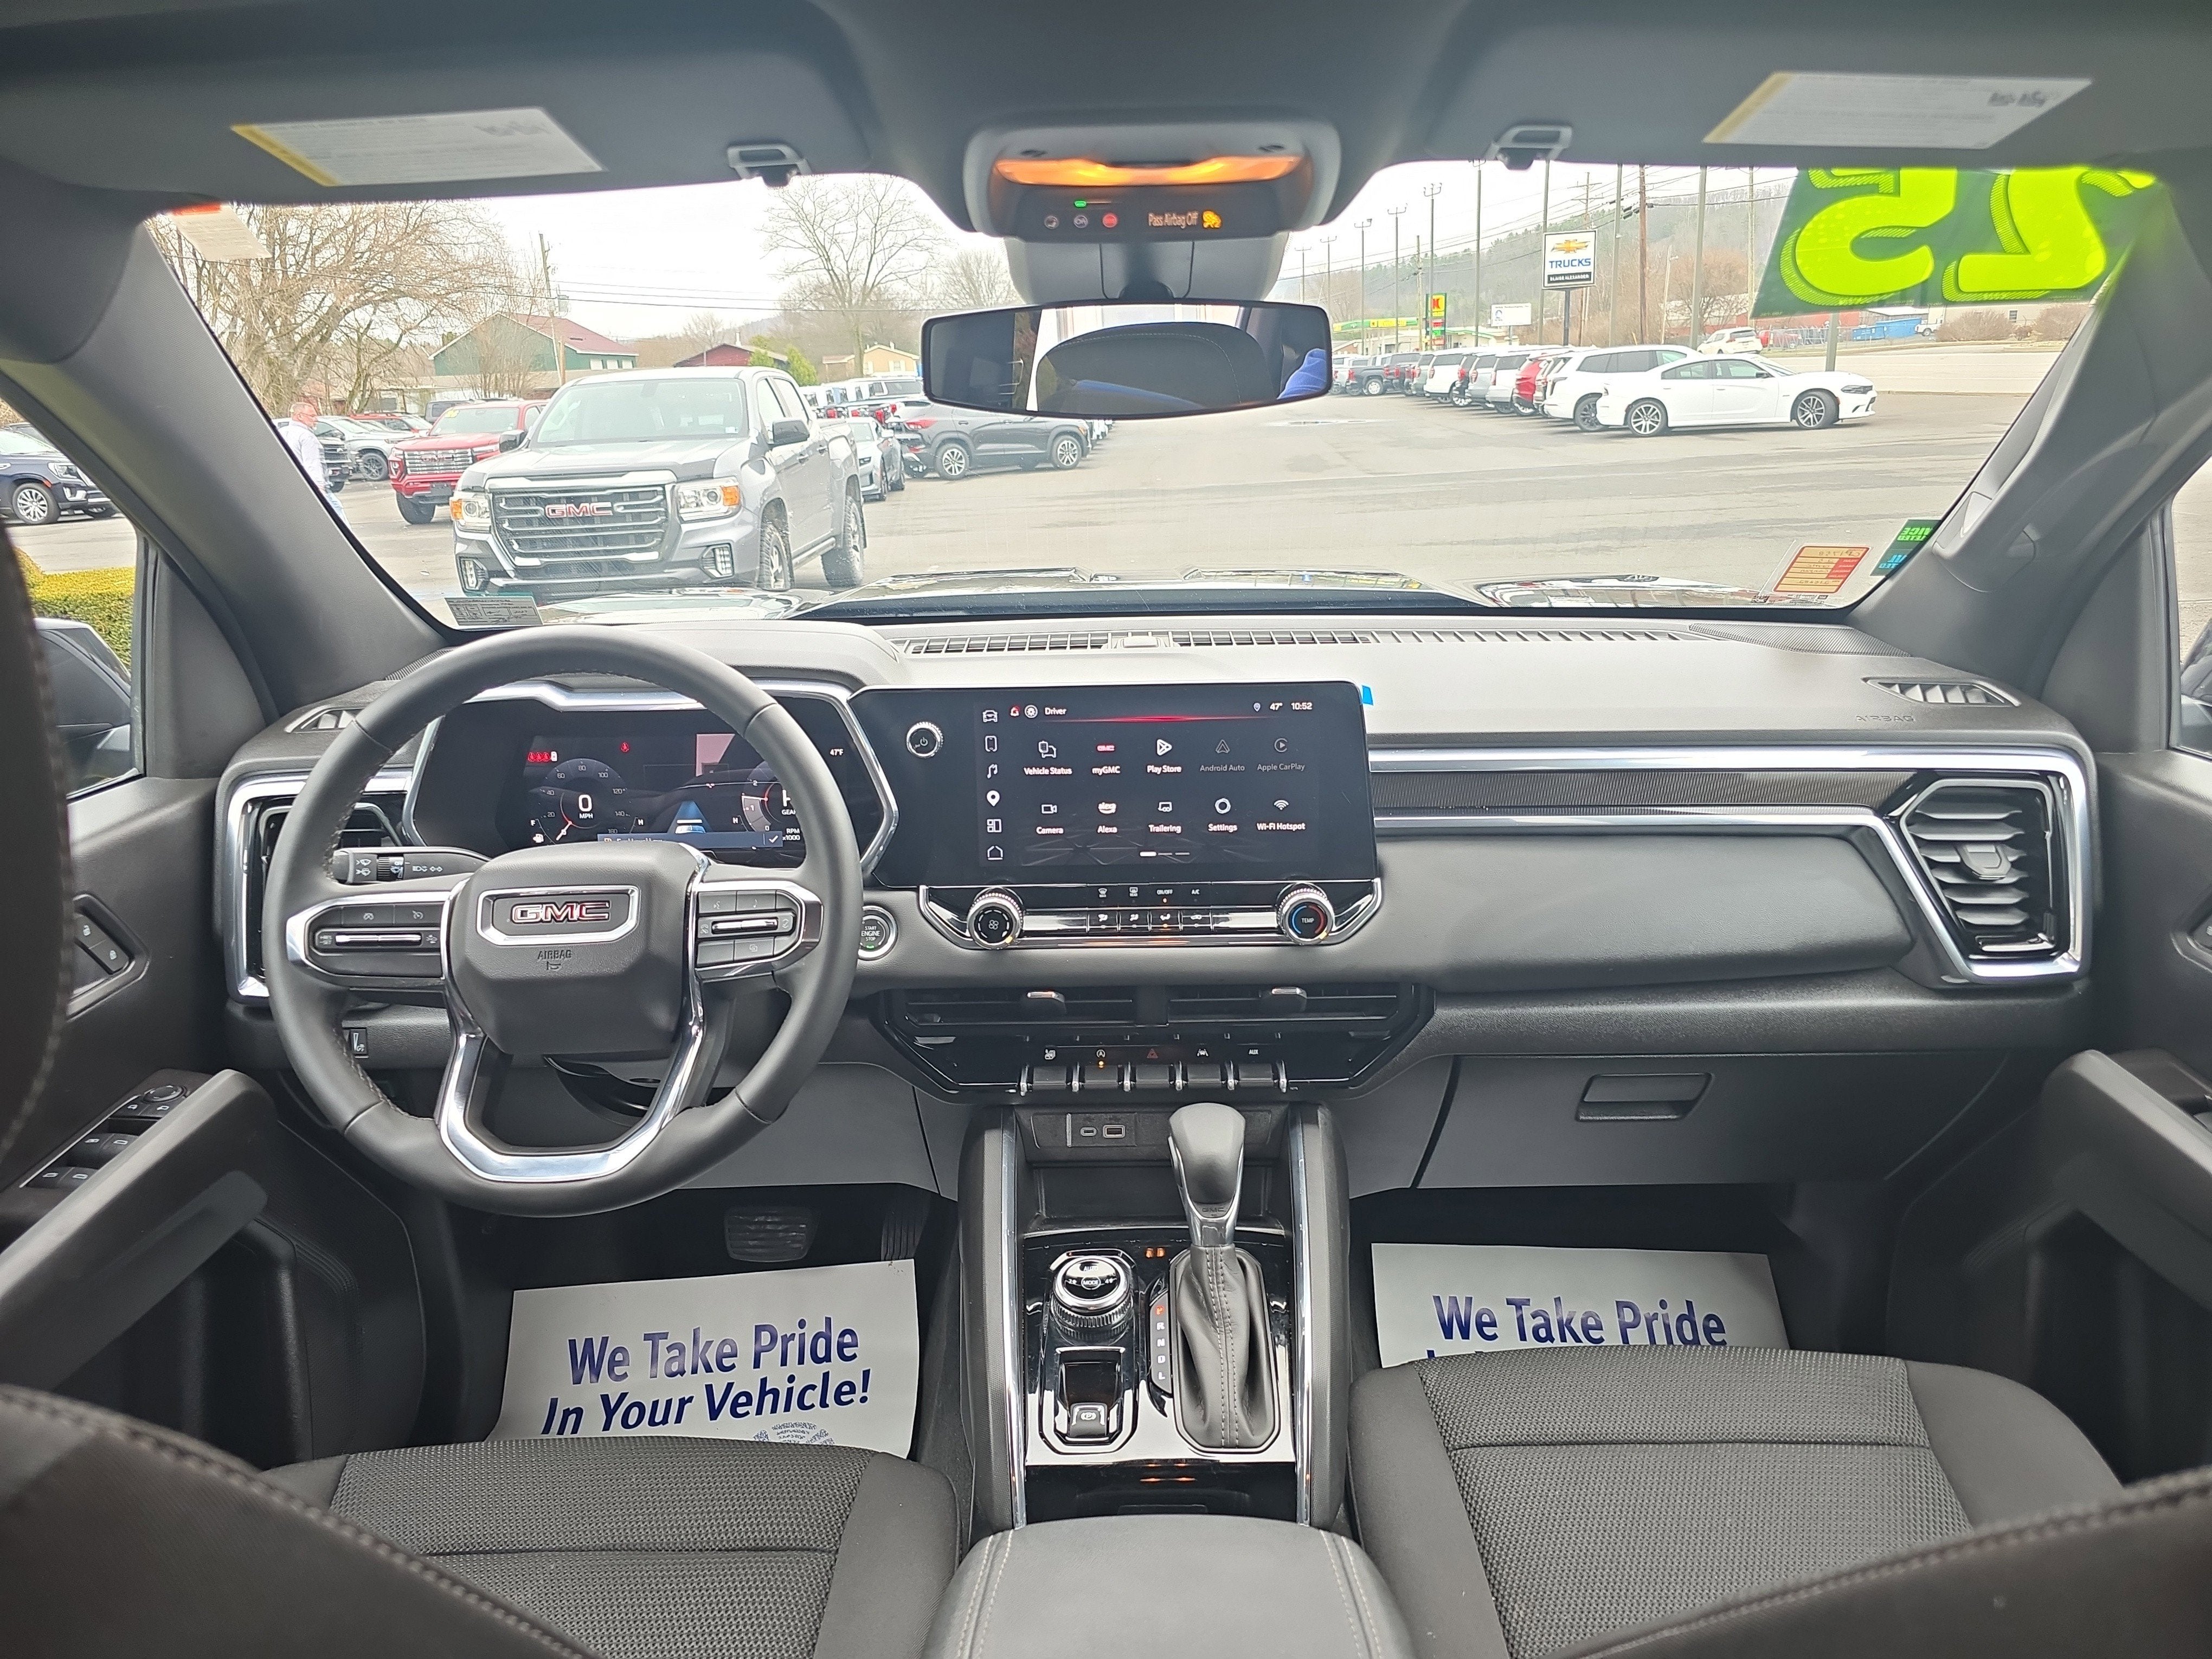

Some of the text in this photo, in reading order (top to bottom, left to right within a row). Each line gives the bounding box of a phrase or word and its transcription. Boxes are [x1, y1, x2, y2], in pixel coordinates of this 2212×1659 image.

[1548, 258, 1591, 269] TRUCKS
[544, 501, 613, 518] GMC
[1291, 702, 1313, 710] 10:52
[1044, 707, 1066, 715] Driver
[1024, 767, 1073, 775] Vehicle Status
[1092, 766, 1121, 775] myGMC
[1147, 765, 1182, 775] Play Store
[1257, 762, 1305, 773] Apple CarPlay
[578, 794, 593, 812] 0
[1036, 826, 1064, 834] Camera
[1097, 825, 1117, 833] Alexa
[1148, 824, 1182, 833] Trailering
[1208, 823, 1238, 833] Settings
[1256, 822, 1306, 832] Wi-Fi Hotspot
[512, 901, 610, 924] GMC
[537, 949, 572, 960] AIRBAG
[1156, 1306, 1165, 1315] P
[1431, 1295, 1728, 1347] We Take Pride
[1156, 1322, 1165, 1330] R
[1157, 1338, 1165, 1347] N
[567, 1316, 859, 1386] We Take Pride
[1158, 1355, 1166, 1364] D
[1158, 1371, 1166, 1380] L
[541, 1368, 871, 1436] In Your Vehicle!
